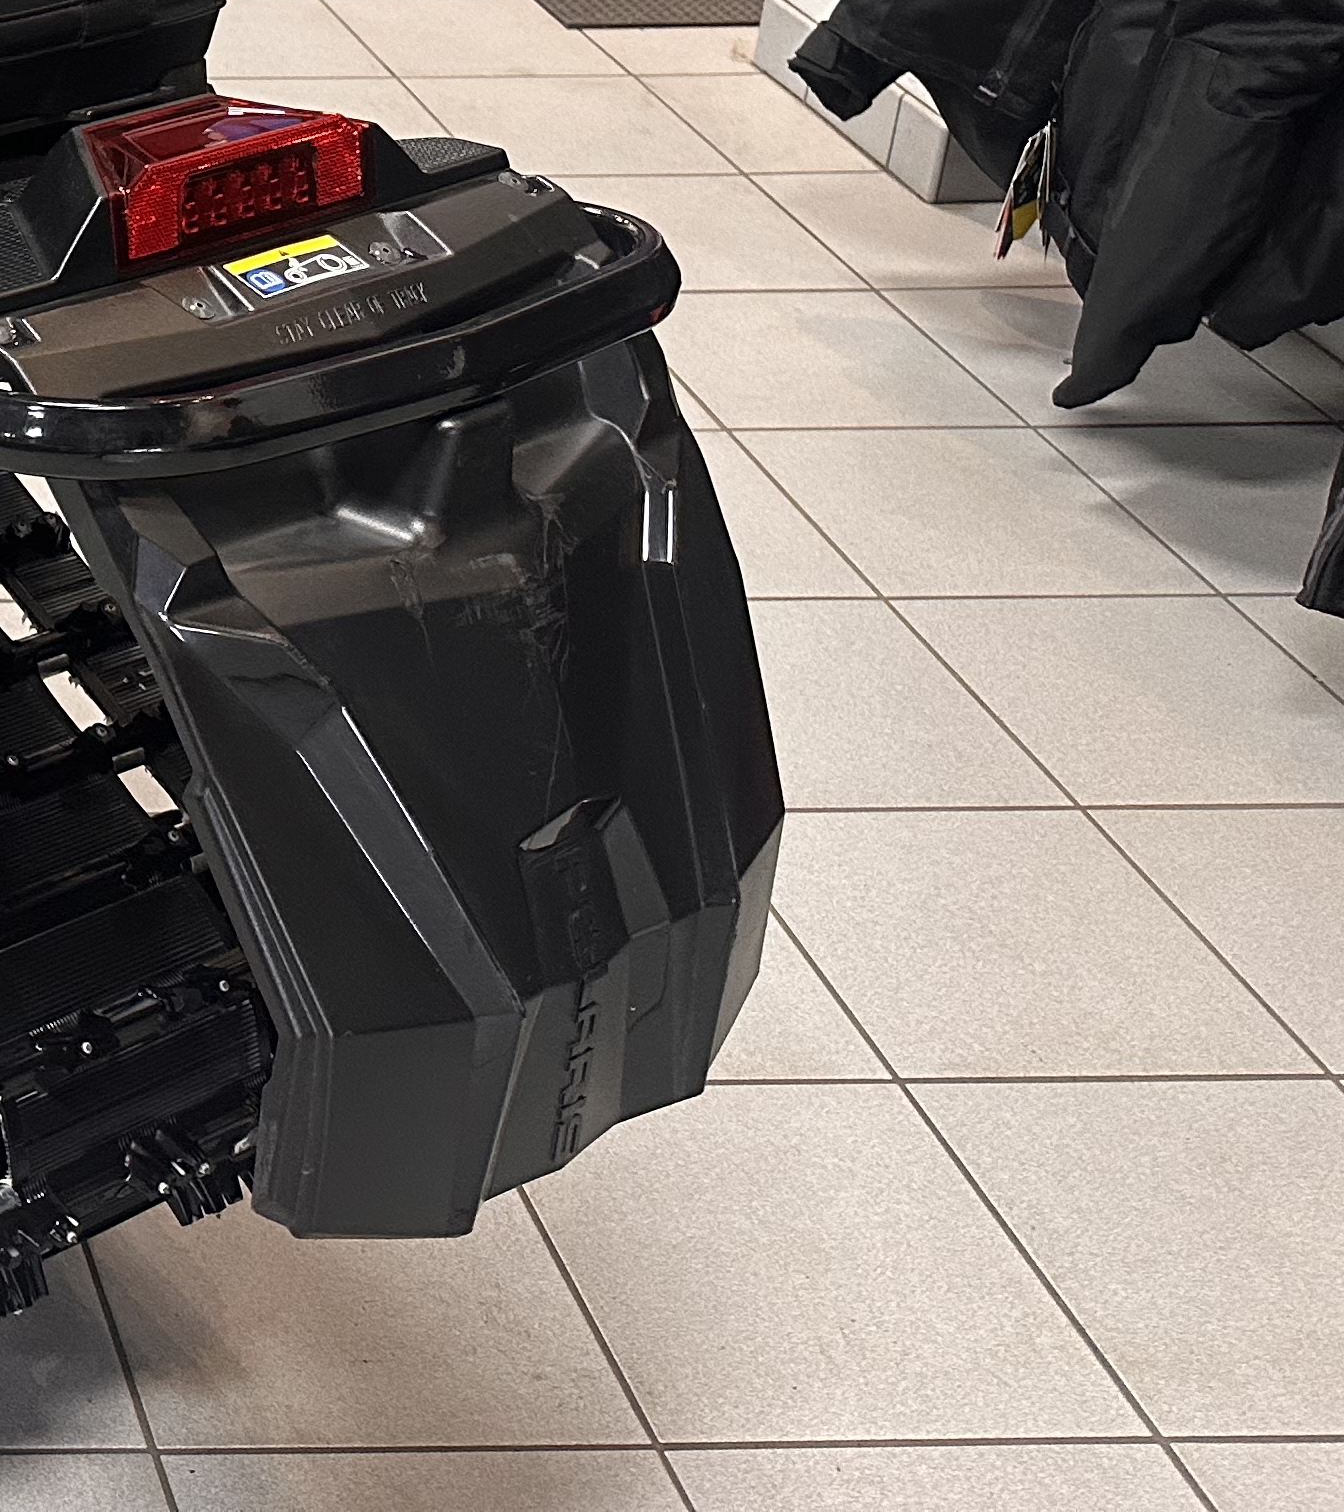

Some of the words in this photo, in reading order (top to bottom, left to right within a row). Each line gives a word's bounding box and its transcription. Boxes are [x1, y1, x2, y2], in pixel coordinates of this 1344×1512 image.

[275, 315, 314, 345] STAY
[318, 300, 365, 331] CLEAR
[366, 293, 385, 316] OF
[389, 281, 428, 311] TRACK
